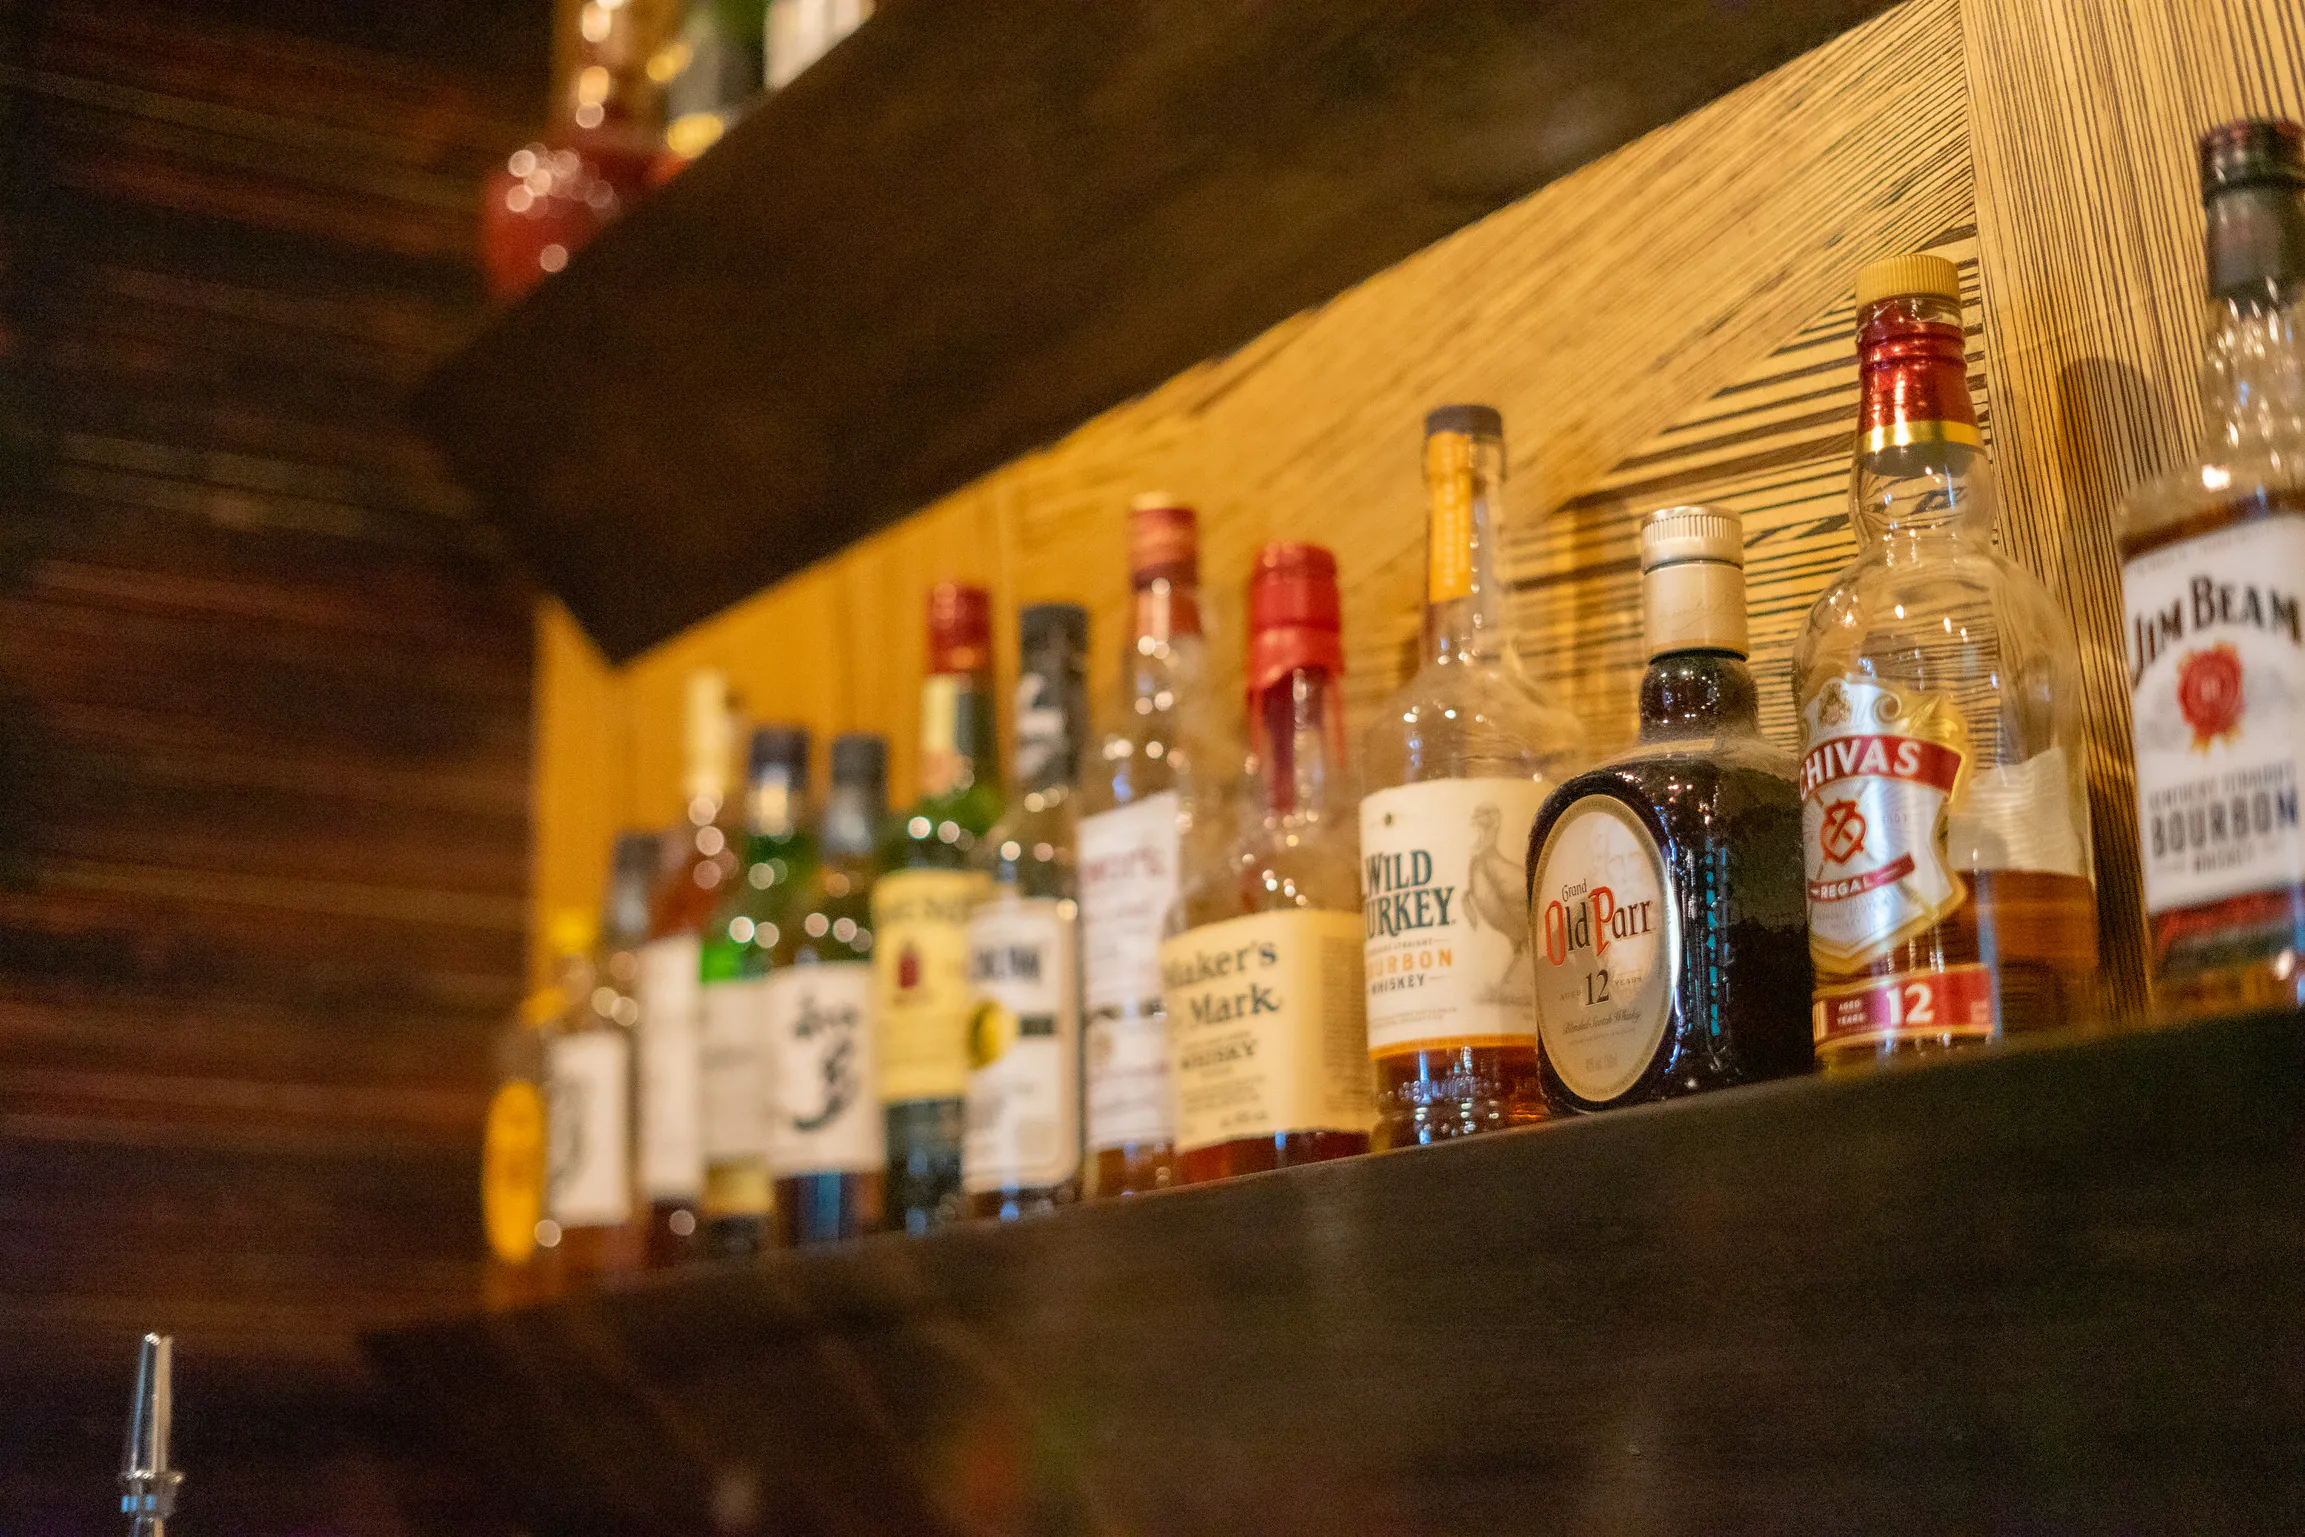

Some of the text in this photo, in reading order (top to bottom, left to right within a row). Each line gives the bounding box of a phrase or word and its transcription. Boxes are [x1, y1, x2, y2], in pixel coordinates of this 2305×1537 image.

[2134, 575, 2300, 687] JIM BEAM
[2152, 789, 2297, 859] BOURBON
[1365, 849, 1432, 898] WILD
[1562, 879, 1587, 902] Grand
[1821, 876, 1875, 898] REGAL
[1366, 886, 1454, 939] URKEY
[1545, 887, 1652, 966] Old Parr
[1366, 948, 1452, 979] OURBON
[1190, 983, 1281, 1025] Mark
[1585, 969, 1610, 1006] 12
[1886, 983, 1934, 1026] 12
